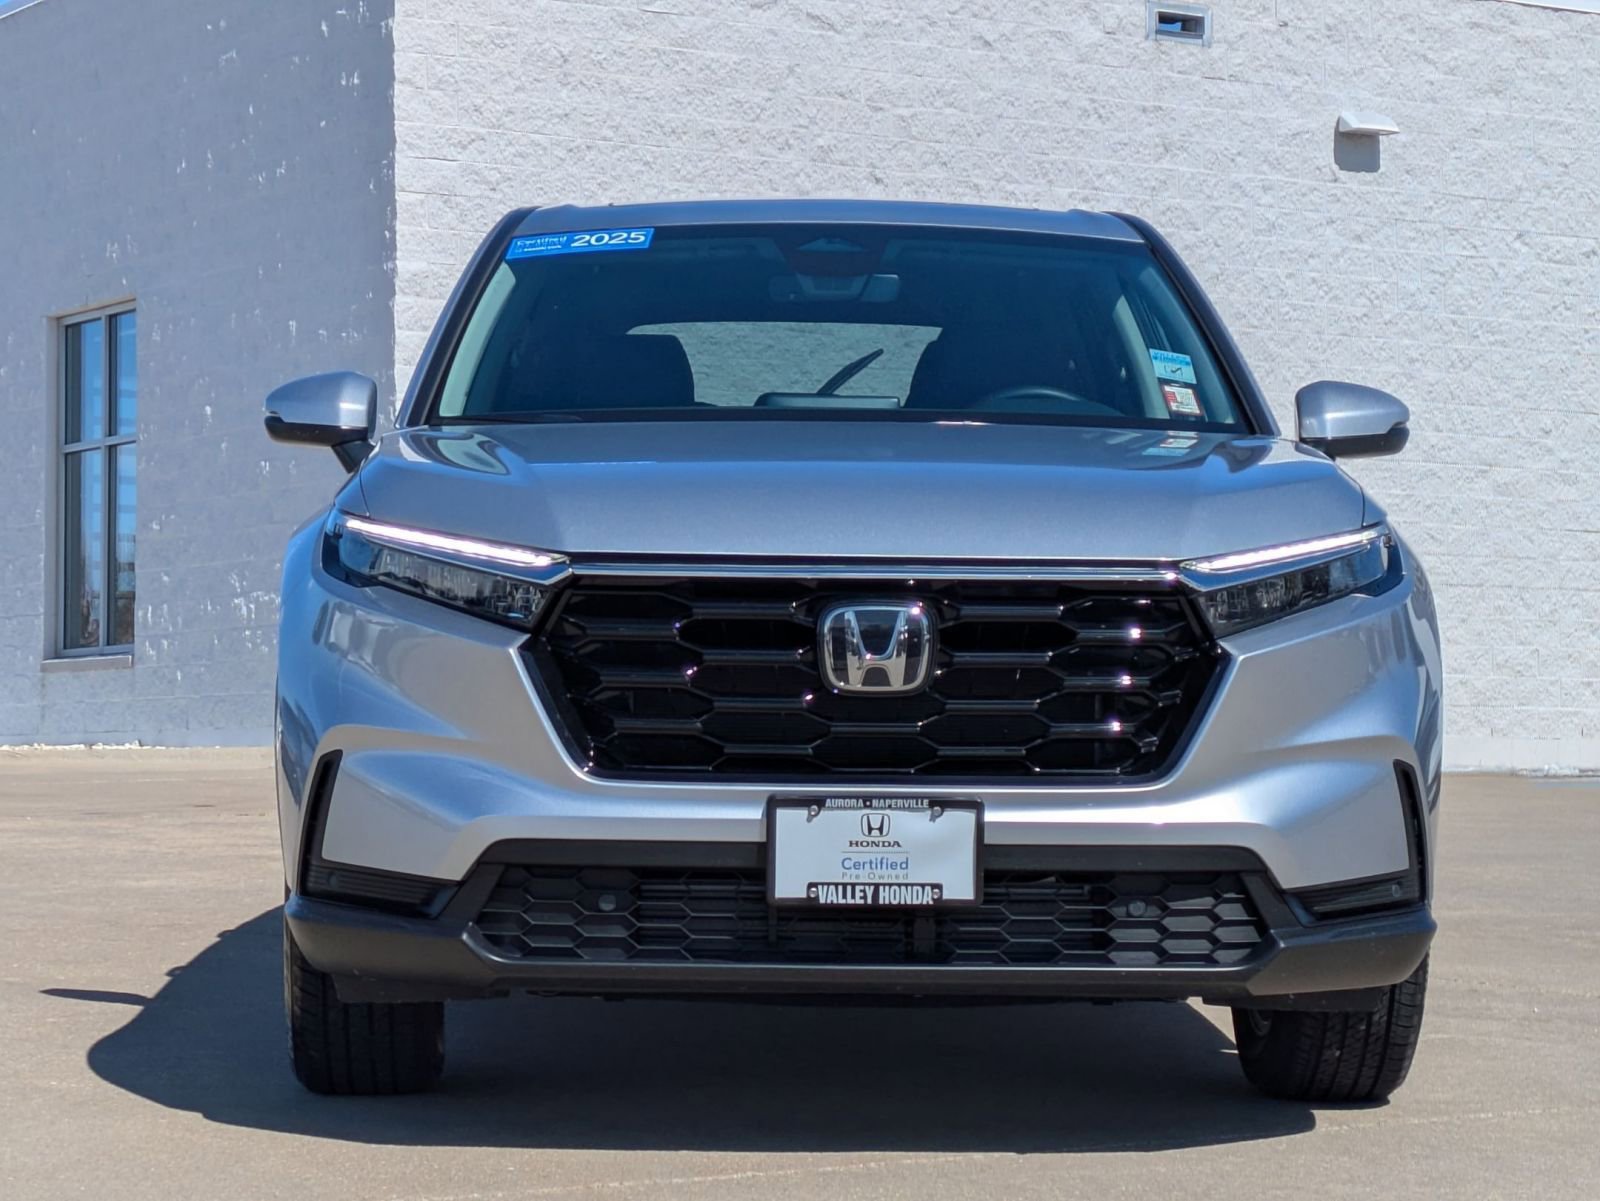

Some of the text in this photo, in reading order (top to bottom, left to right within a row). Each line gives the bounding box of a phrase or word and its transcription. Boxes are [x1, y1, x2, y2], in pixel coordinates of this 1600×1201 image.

[570, 231, 647, 247] 2025
[825, 799, 929, 808] AURORA NAPERVILLE
[848, 840, 902, 848] HONDA
[841, 857, 909, 870] Certified
[841, 872, 909, 880] Pre-Owned
[817, 885, 934, 905] VALLEY HONDA
